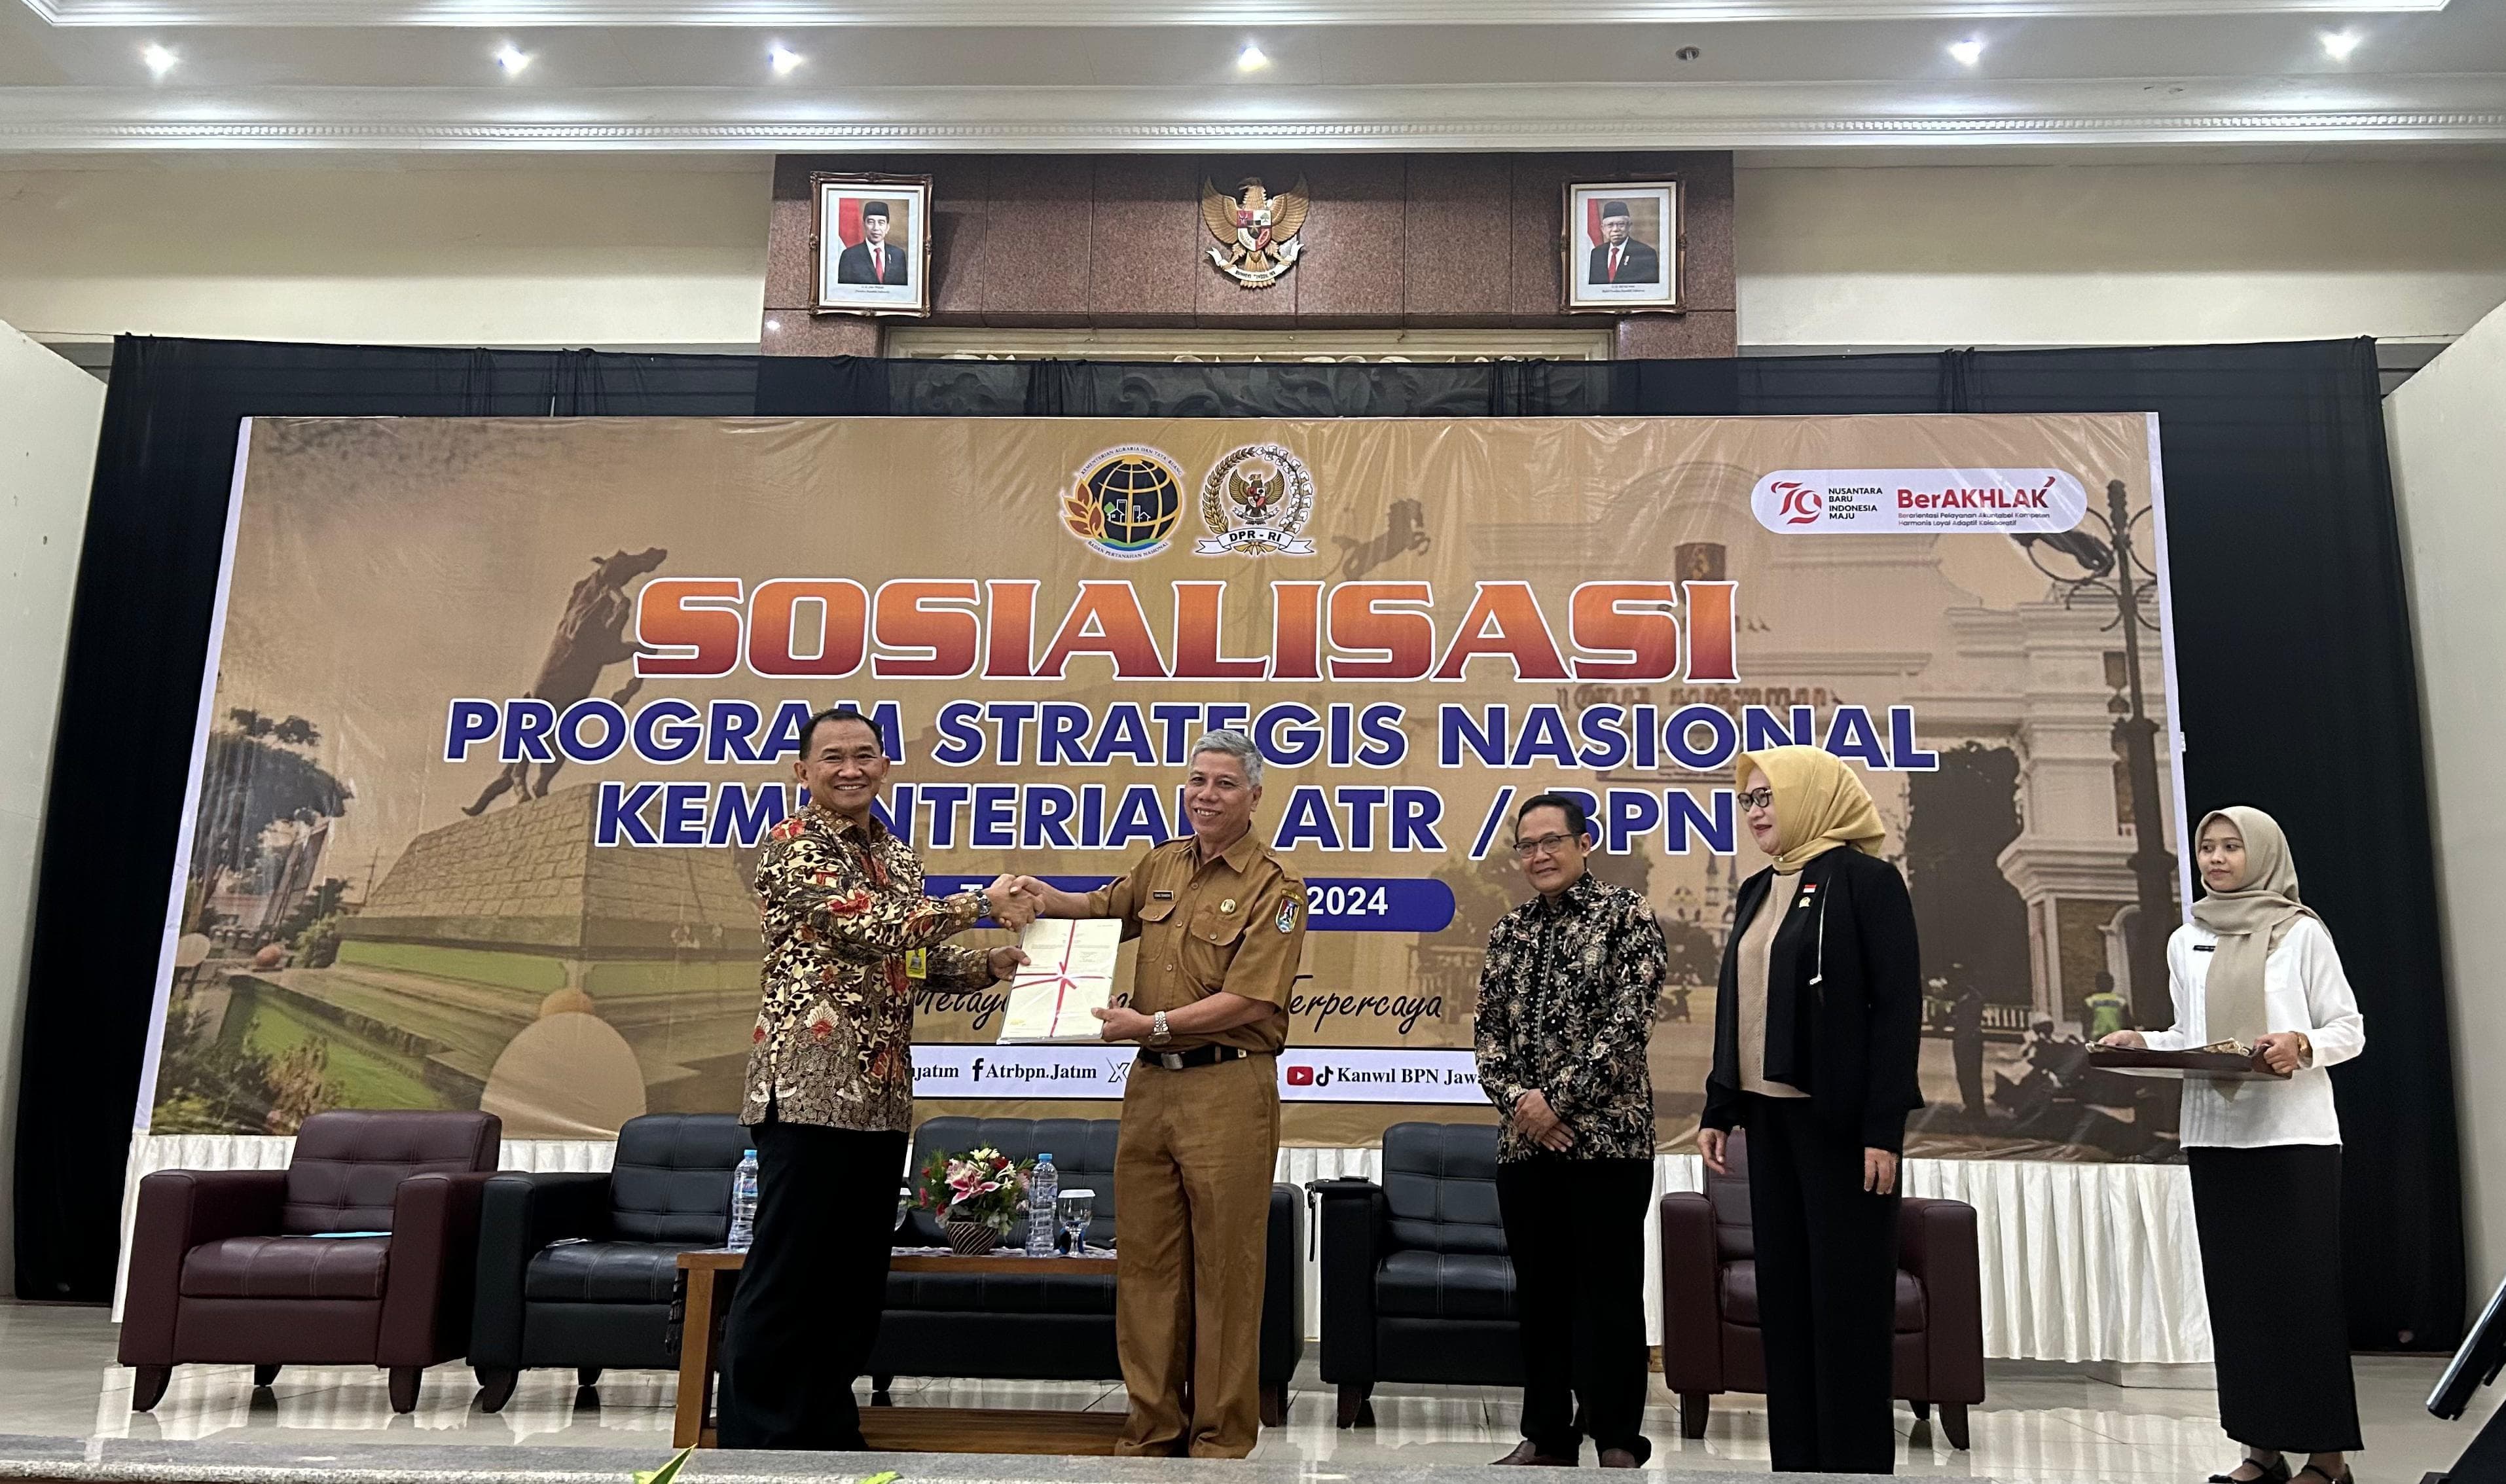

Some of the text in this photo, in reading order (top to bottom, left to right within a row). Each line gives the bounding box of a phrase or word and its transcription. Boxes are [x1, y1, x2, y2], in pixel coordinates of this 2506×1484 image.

[1081, 450, 1114, 475] KEMENTERIAN
[1154, 451, 1167, 460] TATA
[1167, 459, 1184, 475] RUANG
[1898, 477, 2056, 508] BerAKHLAK
[1088, 541, 1104, 553] BADAN
[1143, 542, 1169, 556] NASIONAL
[1229, 530, 1256, 542] DPR
[1267, 531, 1281, 542] RI
[633, 577, 1741, 683] SOSIALISASI
[1438, 703, 1940, 772] NASIONAL
[594, 781, 1199, 852] KEMNTERIA
[1271, 785, 1447, 852] ATR
[1468, 786, 1517, 860] /
[1306, 886, 1389, 915] 2024
[985, 1063, 1097, 1082] Atrbpn.Jatim
[1337, 1067, 1482, 1085] Kanwil BPN Jaw
